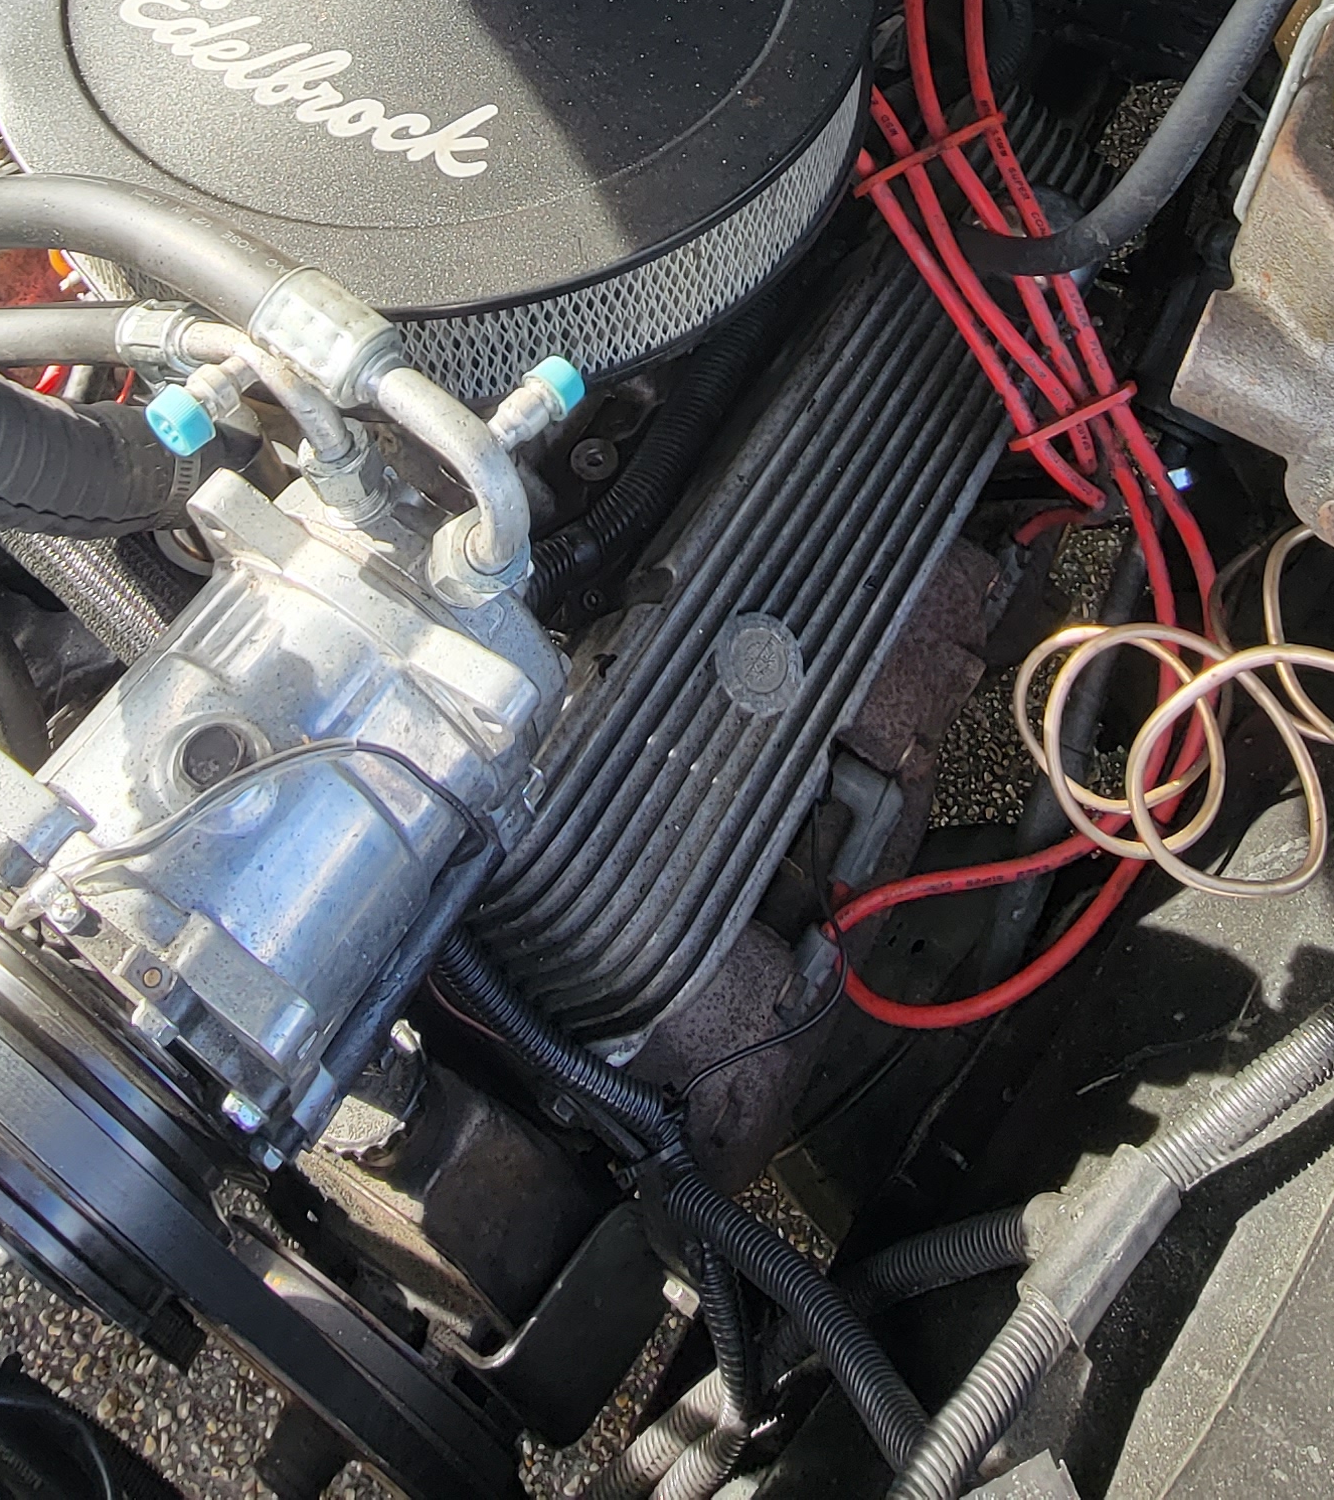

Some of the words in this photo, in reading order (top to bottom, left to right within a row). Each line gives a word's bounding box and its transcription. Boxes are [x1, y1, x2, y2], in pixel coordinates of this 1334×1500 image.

[880, 113, 899, 137] MSD
[1007, 166, 1030, 201] SUPER
[221, 230, 259, 254] HOSE
